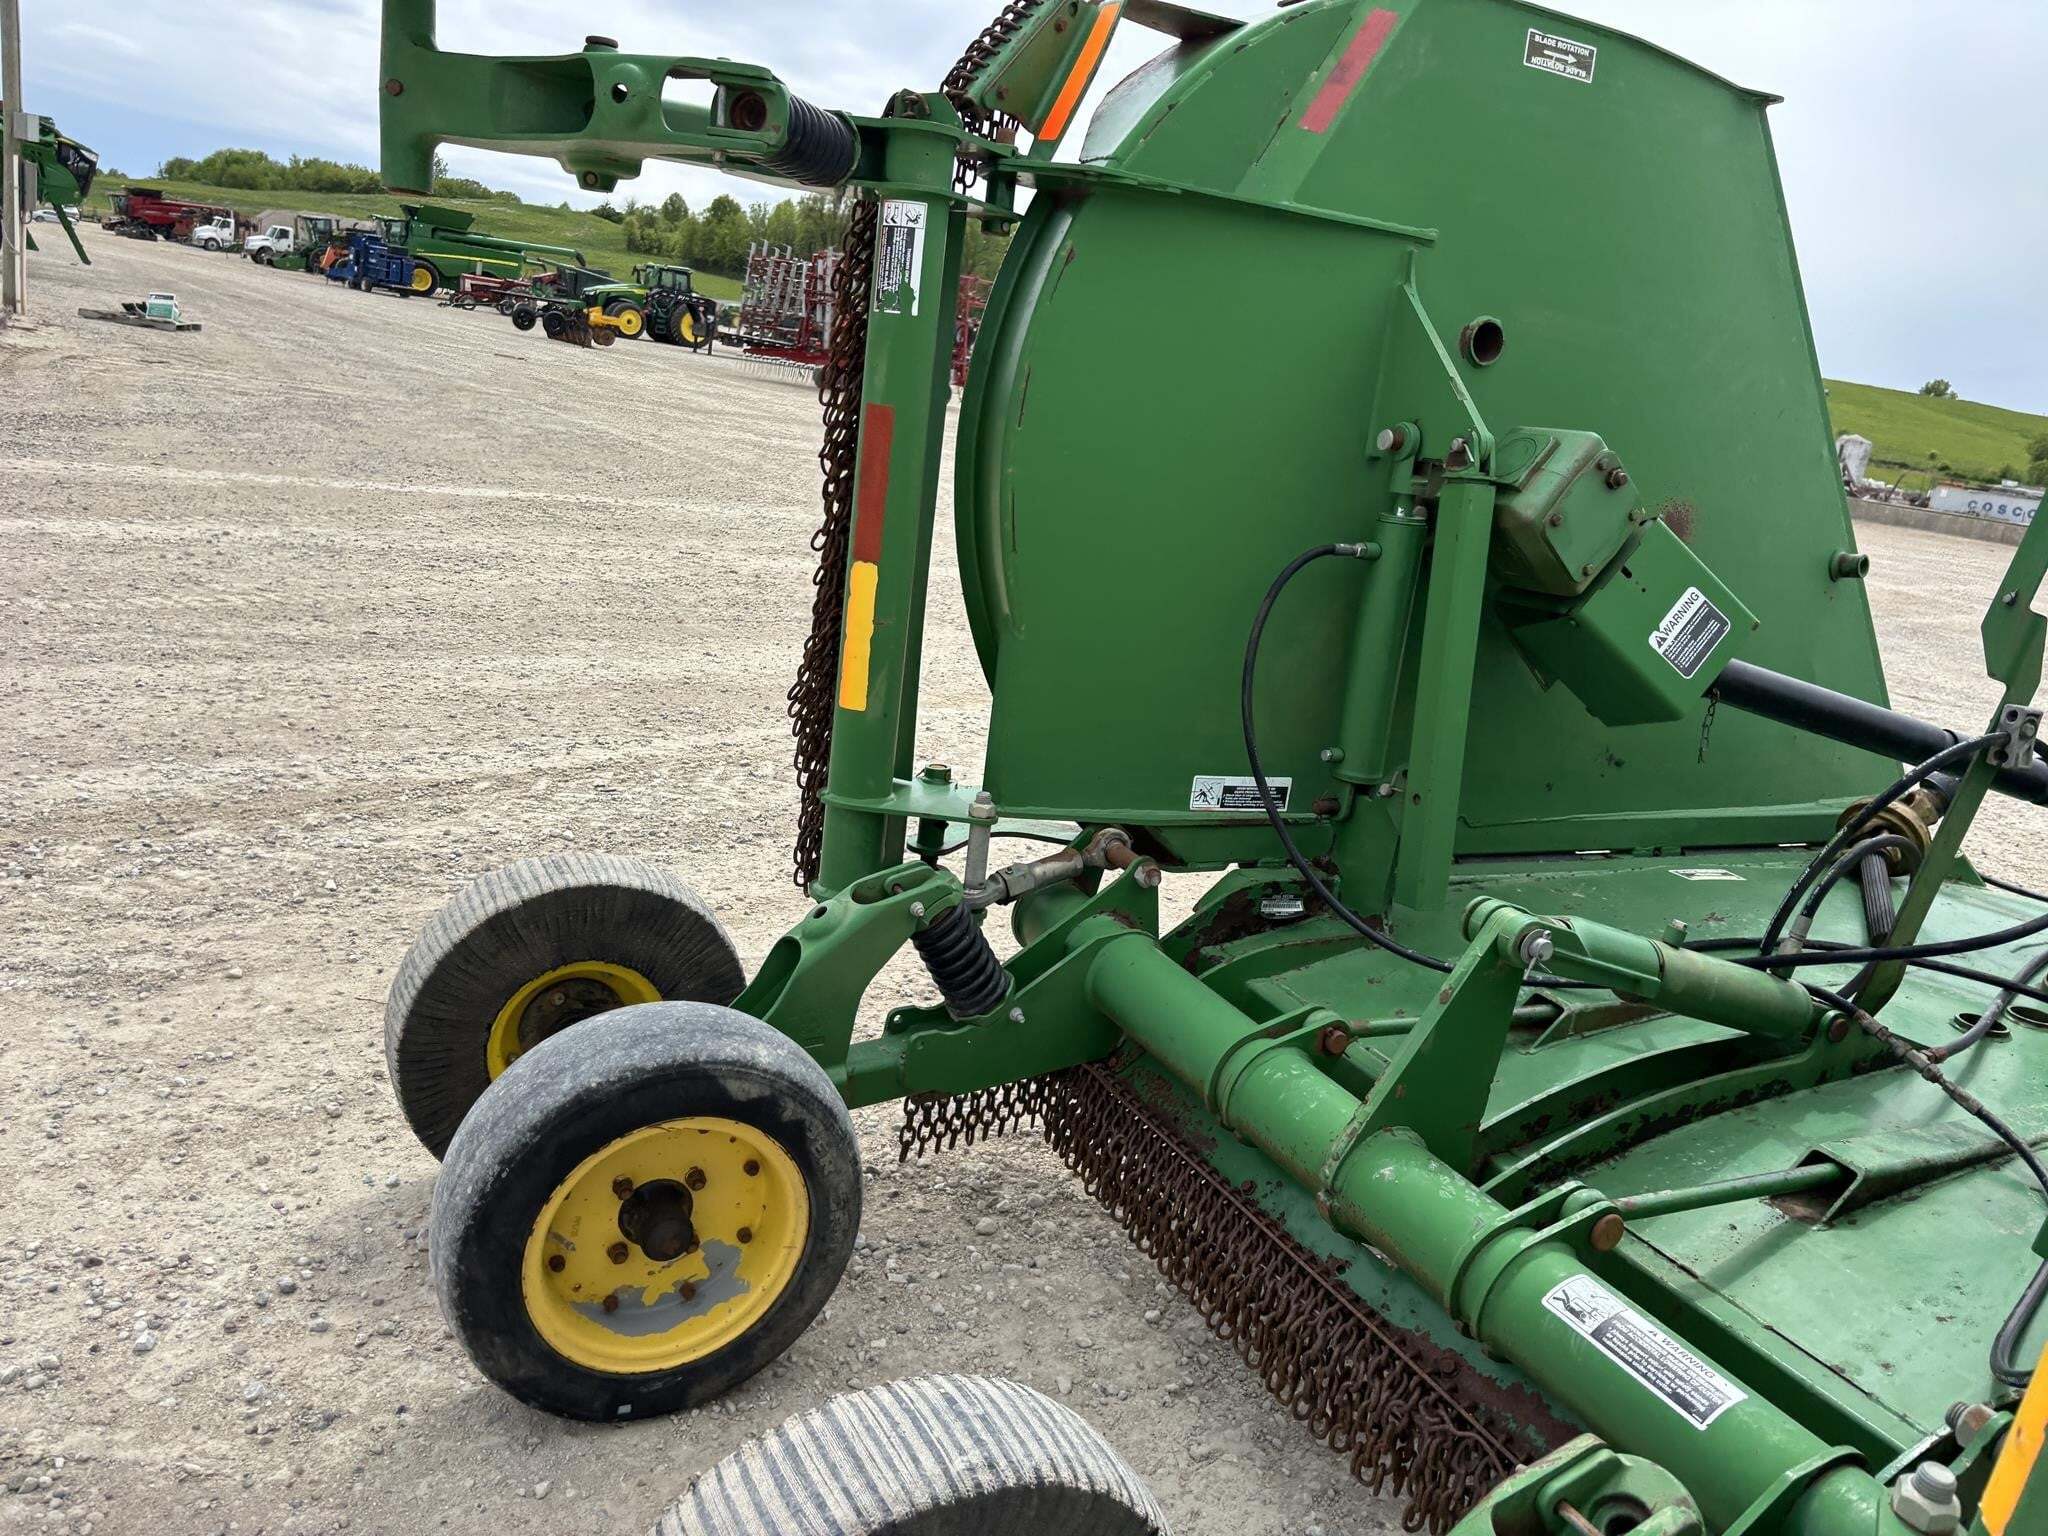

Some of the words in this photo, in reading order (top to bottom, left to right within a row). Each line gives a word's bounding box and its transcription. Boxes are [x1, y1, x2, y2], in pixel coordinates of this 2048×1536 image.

[1534, 34, 1556, 47] BLADE
[1557, 41, 1589, 57] ROTATION
[1531, 56, 1564, 71] ROTATION
[1565, 66, 1586, 78] BLADE
[1967, 500, 2037, 519] COSCO
[1663, 591, 1699, 637] WARNING
[1626, 1331, 1662, 1358] ACCIDENTAL
[1659, 1356, 1692, 1380] LOWERING
[1696, 1384, 1723, 1405] CUTTER
[1659, 1337, 1717, 1379] WARNING
